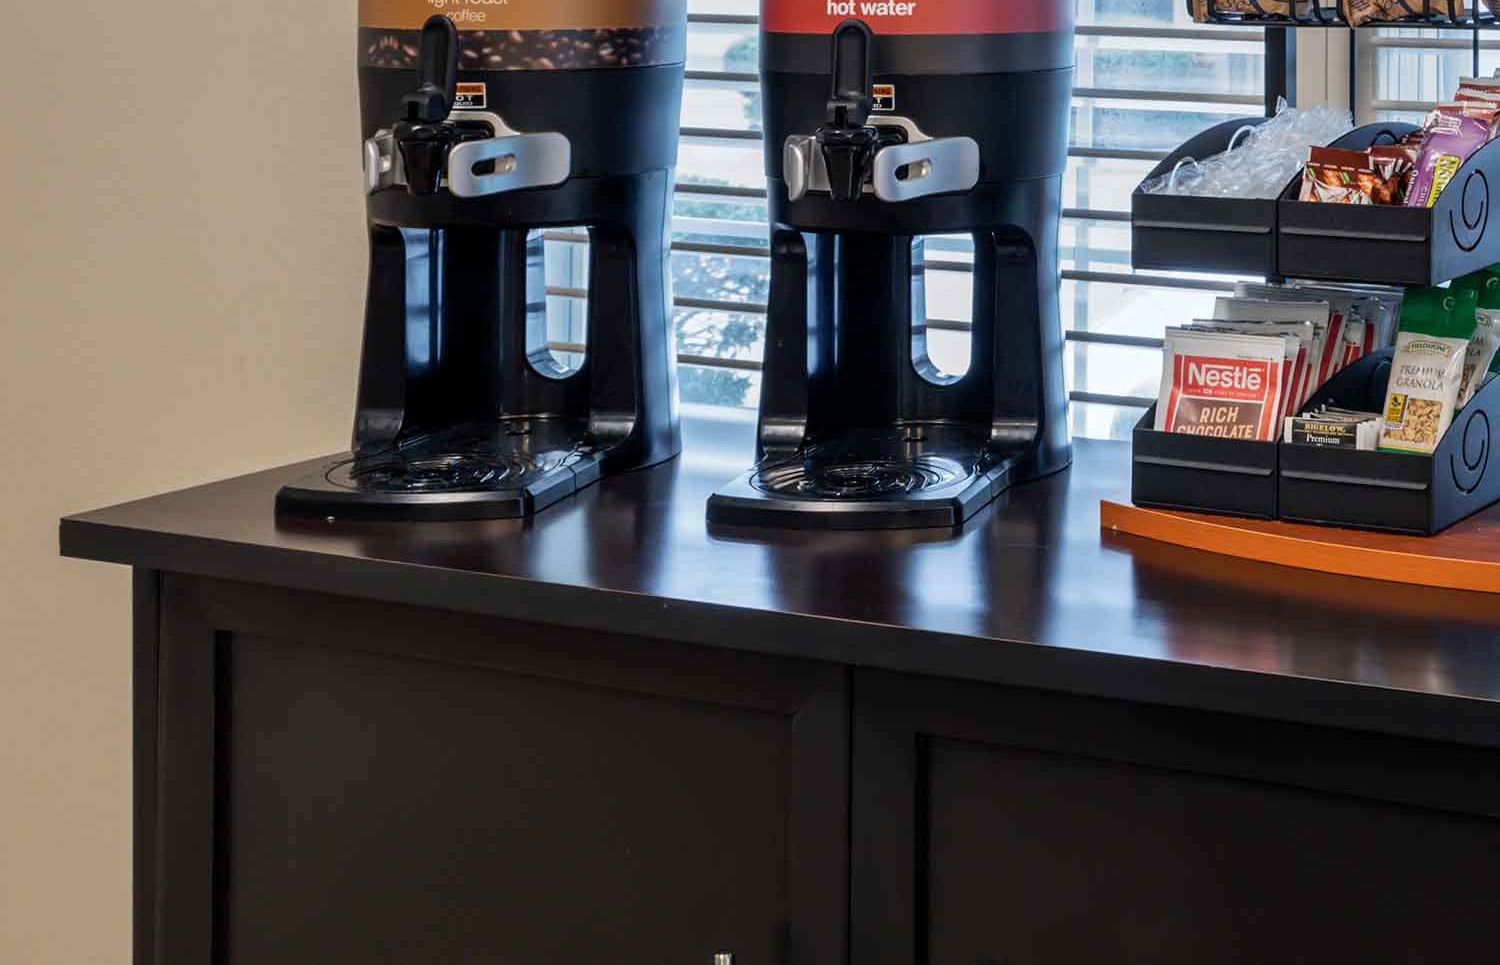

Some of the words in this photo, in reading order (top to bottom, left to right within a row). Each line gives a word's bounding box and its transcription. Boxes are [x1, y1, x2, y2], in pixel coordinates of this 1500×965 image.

[446, 8, 487, 23] coffee
[860, 0, 917, 16] water
[1396, 377, 1444, 392] GRANOLA
[1199, 406, 1240, 423] RICH
[1176, 424, 1254, 439] CHOCOLATE
[1306, 433, 1340, 445] Premium
